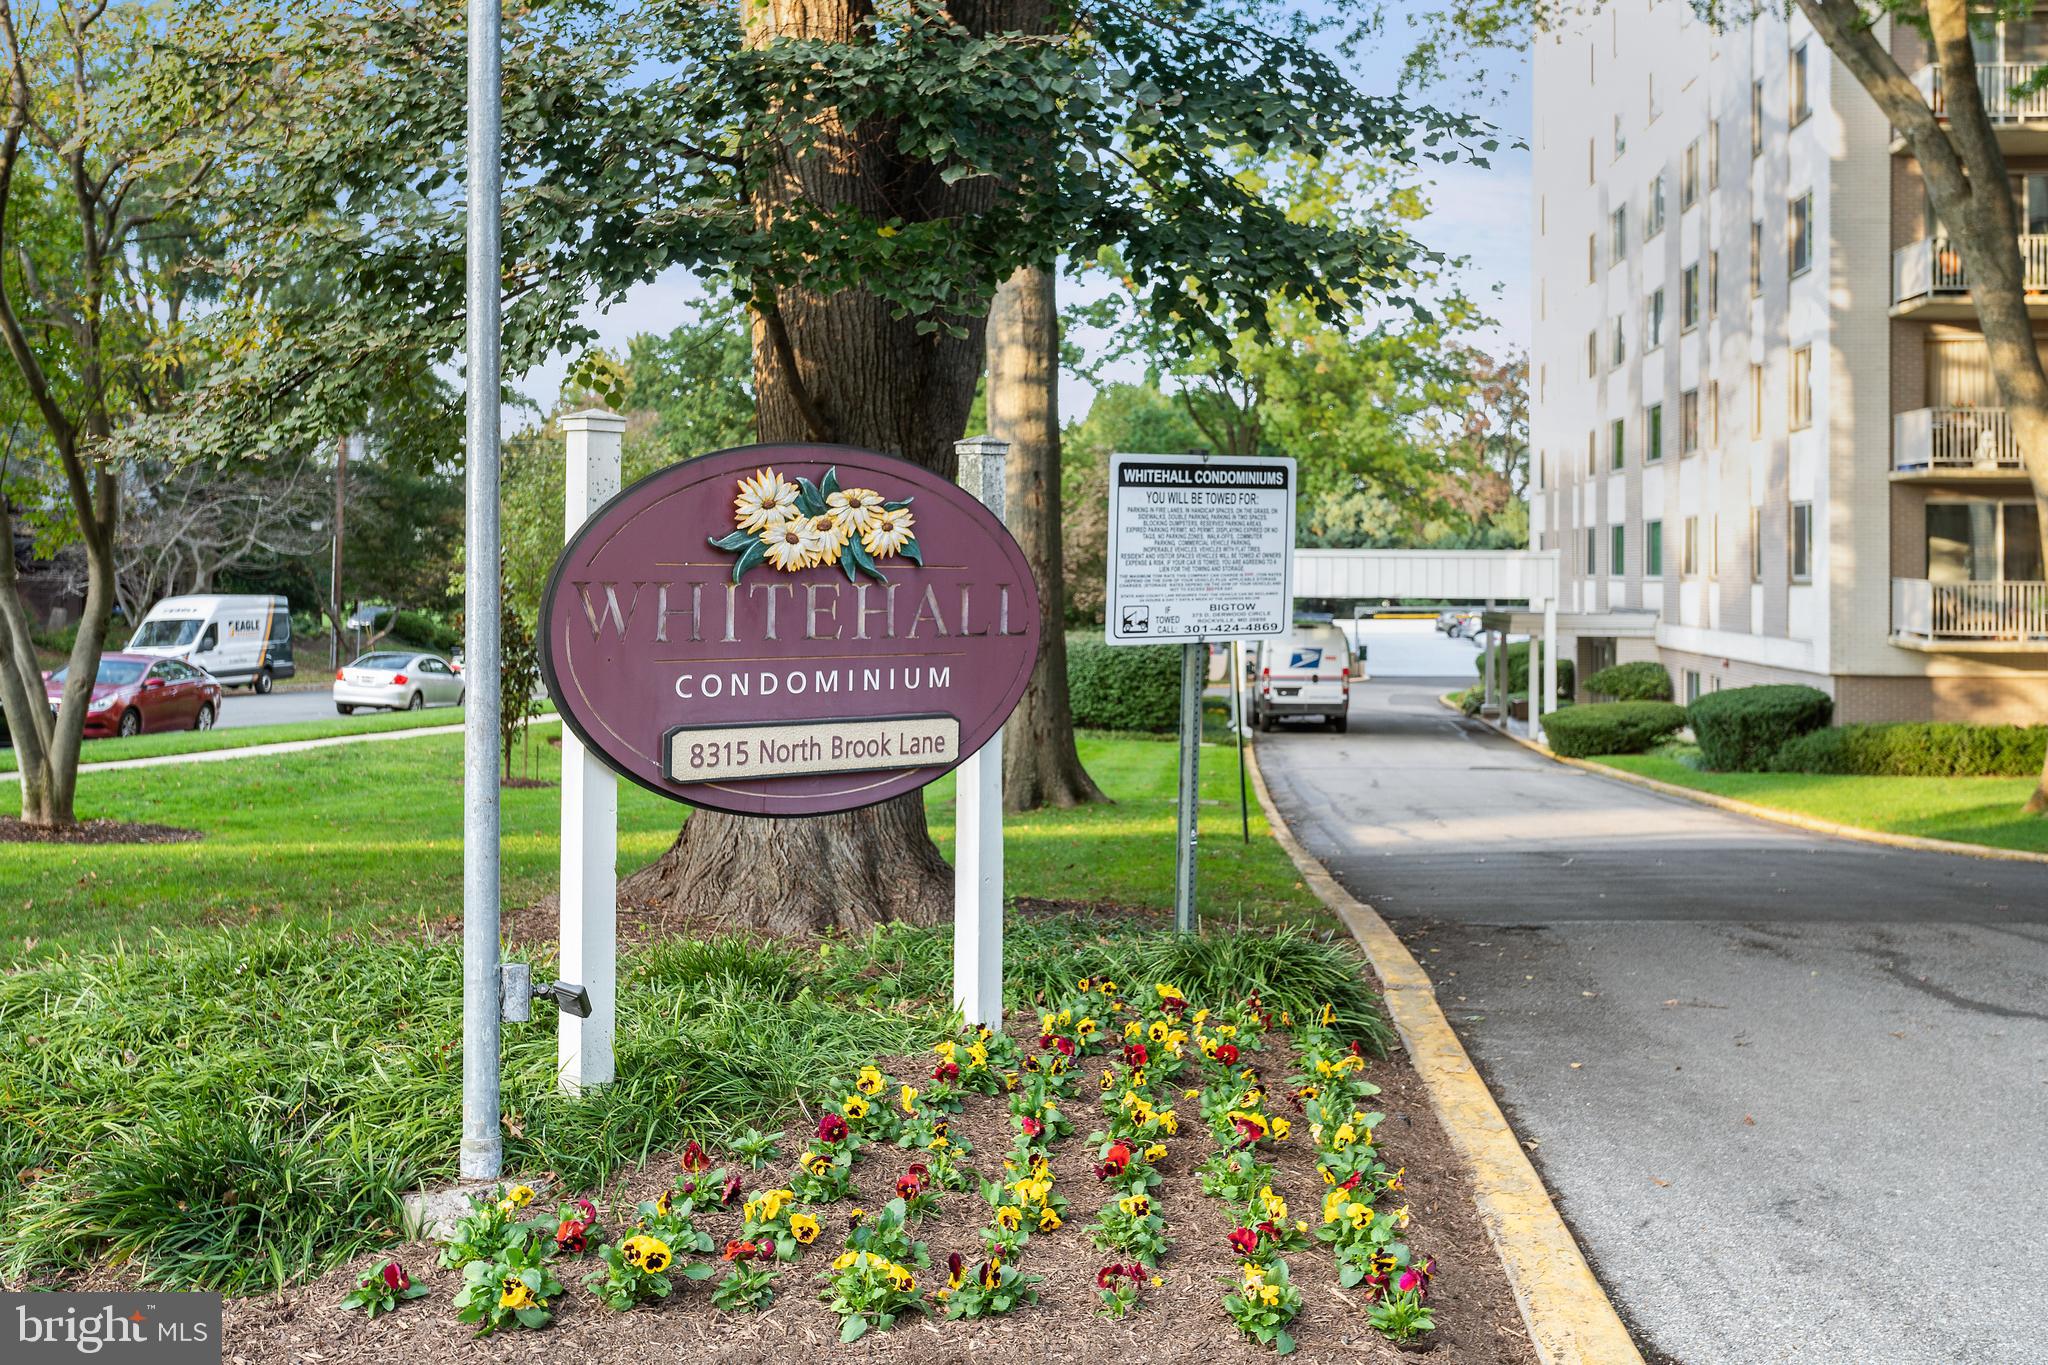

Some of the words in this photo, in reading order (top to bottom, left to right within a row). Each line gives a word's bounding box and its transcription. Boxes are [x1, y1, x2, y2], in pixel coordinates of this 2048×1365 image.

[1123, 469, 1193, 483] WHITEHALL
[1194, 470, 1284, 485] CONDOMINIUMS
[1146, 491, 1165, 504] YOU
[1167, 492, 1188, 504] WILL
[1191, 492, 1203, 504] BE
[1205, 492, 1237, 505] TOWED
[1239, 493, 1259, 505] FOR:
[571, 579, 1030, 645] WHITEHALL
[1165, 606, 1171, 614] IF
[1209, 603, 1256, 611] BIGTOW
[235, 620, 260, 632] EAGLE
[1155, 616, 1180, 624] TOWED
[1184, 623, 1278, 633] 301-424-4869
[675, 666, 952, 699] CONDOMINIUM
[690, 740, 749, 769] 8315
[759, 737, 822, 766] North
[831, 734, 892, 760] Brook
[899, 731, 946, 756] Lane
